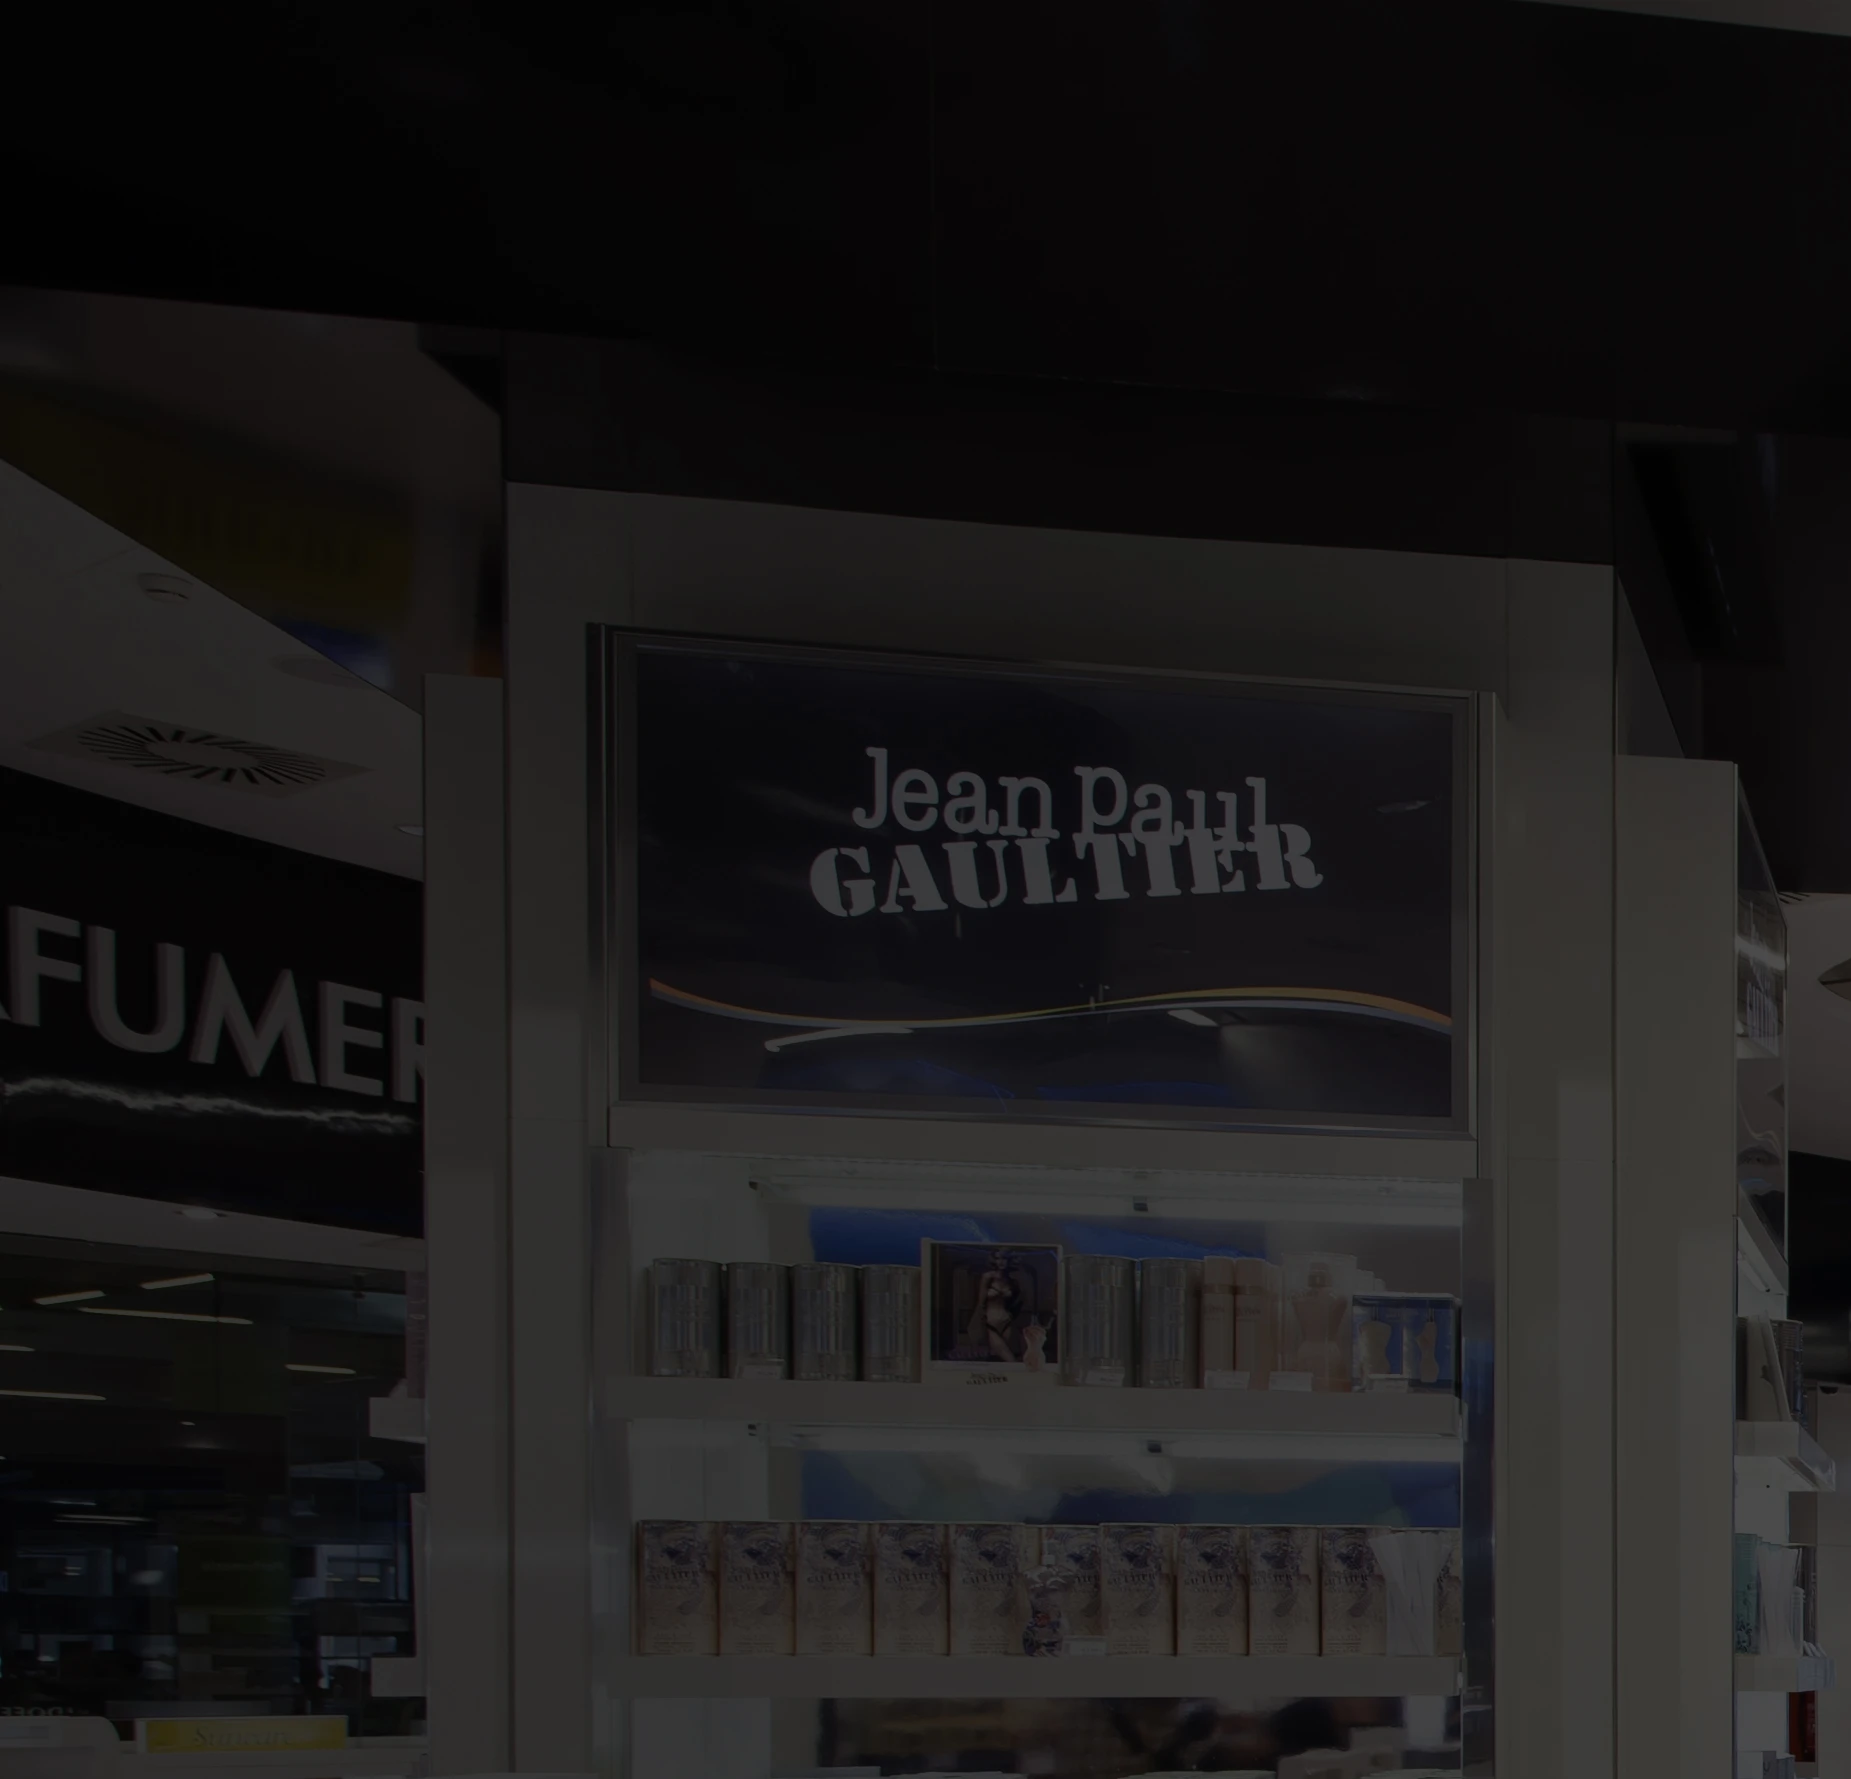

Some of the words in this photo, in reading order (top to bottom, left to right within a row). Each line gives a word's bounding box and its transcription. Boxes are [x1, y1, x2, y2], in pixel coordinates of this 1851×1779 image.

[852, 747, 1060, 839] Jean
[808, 823, 1324, 917] GAULTIER
[0, 904, 425, 1104] FUMER
